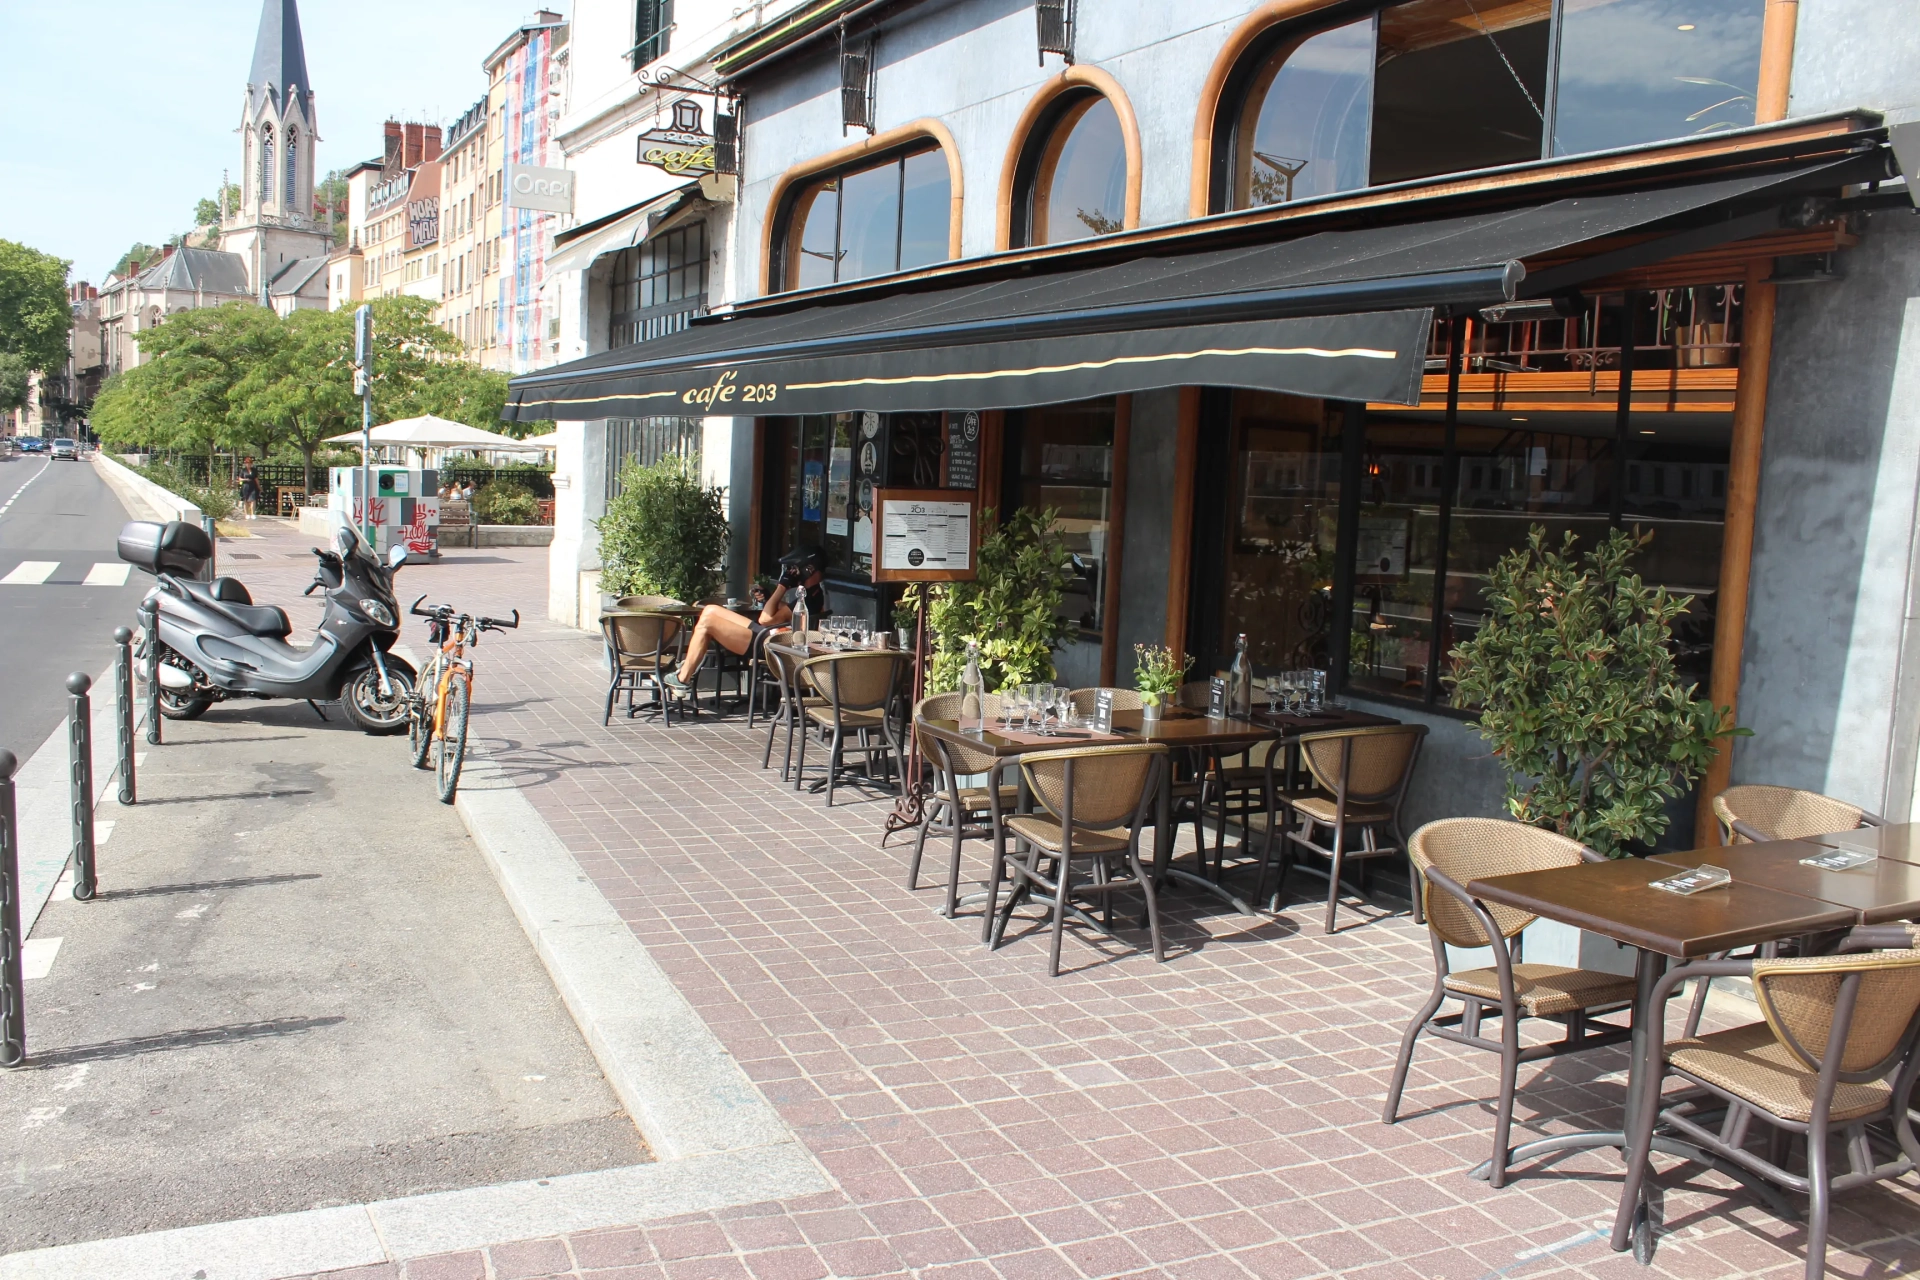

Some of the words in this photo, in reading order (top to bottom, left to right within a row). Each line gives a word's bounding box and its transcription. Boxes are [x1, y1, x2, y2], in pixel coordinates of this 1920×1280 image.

[664, 131, 709, 145] 203
[514, 173, 569, 199] ORPI
[682, 370, 738, 412] café
[742, 383, 777, 403] 203
